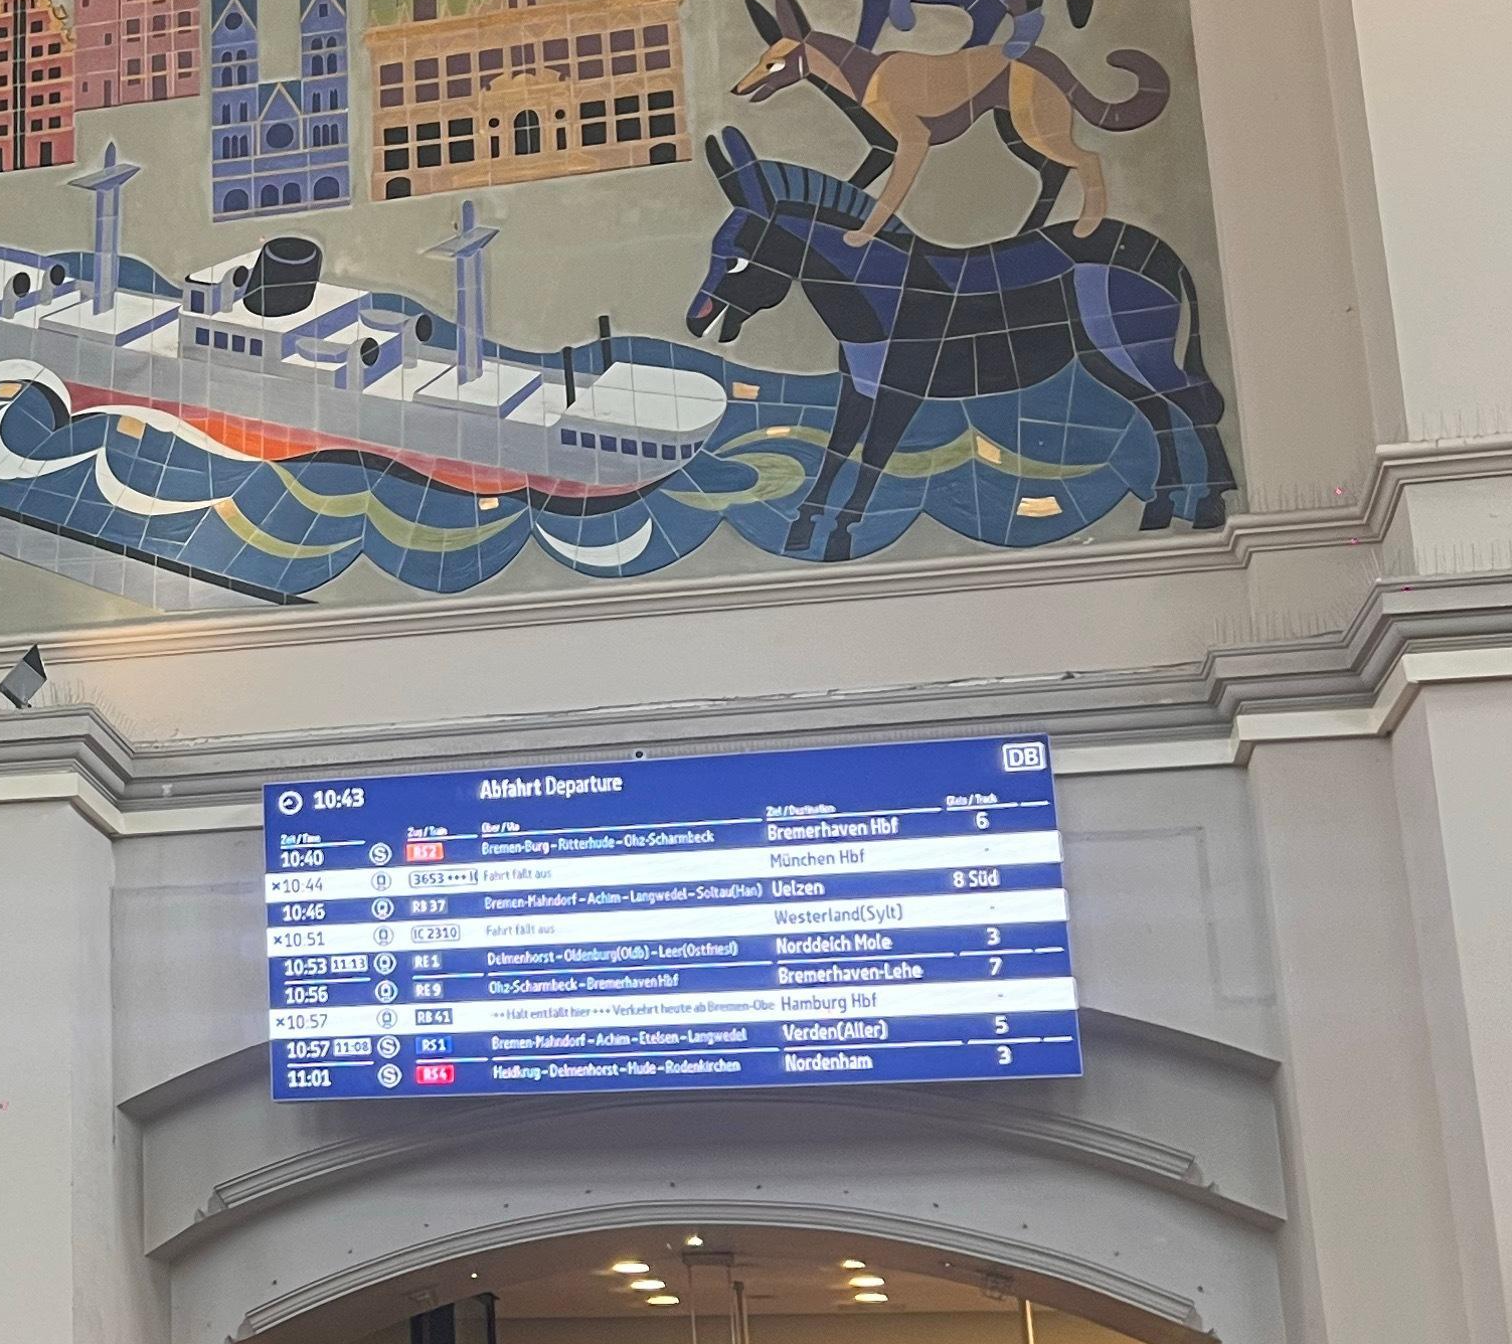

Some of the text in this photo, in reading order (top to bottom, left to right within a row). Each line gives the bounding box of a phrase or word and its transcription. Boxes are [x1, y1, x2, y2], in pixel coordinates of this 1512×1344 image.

[312, 744, 1042, 810] 10:43 Abfahrt Departure DB
[280, 848, 324, 868] 10:40
[481, 838, 550, 857] Bremen-Burg
[557, 834, 615, 851] Ritterhude
[623, 828, 715, 847] Ohz-Scharmbeck
[766, 818, 868, 841] Bremerhaven
[870, 816, 900, 836] Hbf
[973, 811, 990, 830] 6
[282, 876, 323, 893] 10:44
[413, 872, 444, 884] 3653
[483, 869, 510, 881] Fahrt
[534, 868, 551, 879] aus
[769, 849, 836, 868] München
[838, 848, 865, 865] Hbf
[281, 902, 326, 921] 10:46
[429, 898, 446, 912] 37
[483, 892, 578, 910] Bremen-Mahndorf
[586, 890, 621, 905] Achim
[629, 886, 687, 905] Langwedel
[770, 878, 825, 897] Uelzen
[951, 871, 965, 888] 8
[967, 868, 1000, 887] Süd
[284, 930, 325, 947] 10:51
[413, 928, 425, 939] IC
[426, 926, 457, 939] 2310
[485, 923, 513, 936] Fahrt
[773, 902, 903, 927] Westerland(Sylt)
[283, 957, 328, 976] 10:53
[413, 954, 429, 968] RE
[486, 948, 555, 966] Delmenhorst
[775, 934, 851, 955] Norddeich
[854, 932, 893, 952] Mole
[985, 926, 1002, 946] 3
[284, 984, 329, 1004] 10:56
[414, 983, 431, 997] RE
[488, 977, 578, 994] Ohz-Scharmbeck
[777, 961, 924, 985] Bremerhaven-Lehe
[987, 957, 1004, 976] 7
[286, 1013, 328, 1030] 10:57
[416, 1011, 432, 1024] RB
[660, 1001, 692, 1014] heute
[693, 1000, 705, 1013] ab
[779, 993, 847, 1015] Hamburg
[850, 992, 878, 1008] Hbf
[286, 1039, 331, 1059] 10:57
[491, 1032, 586, 1050] Bremen-Mahndorf
[594, 1031, 631, 1046] Achim
[686, 1026, 748, 1046] Langwedel
[781, 1019, 889, 1044] Verden(Aller)
[993, 1014, 1010, 1034] 5
[287, 1068, 331, 1088] 11:01
[548, 1061, 619, 1078] Delmenhorst
[627, 1059, 656, 1075] Hude
[664, 1057, 741, 1074] Rodenkirchen
[783, 1051, 874, 1072] Nordenham
[997, 1046, 1013, 1065] 3
